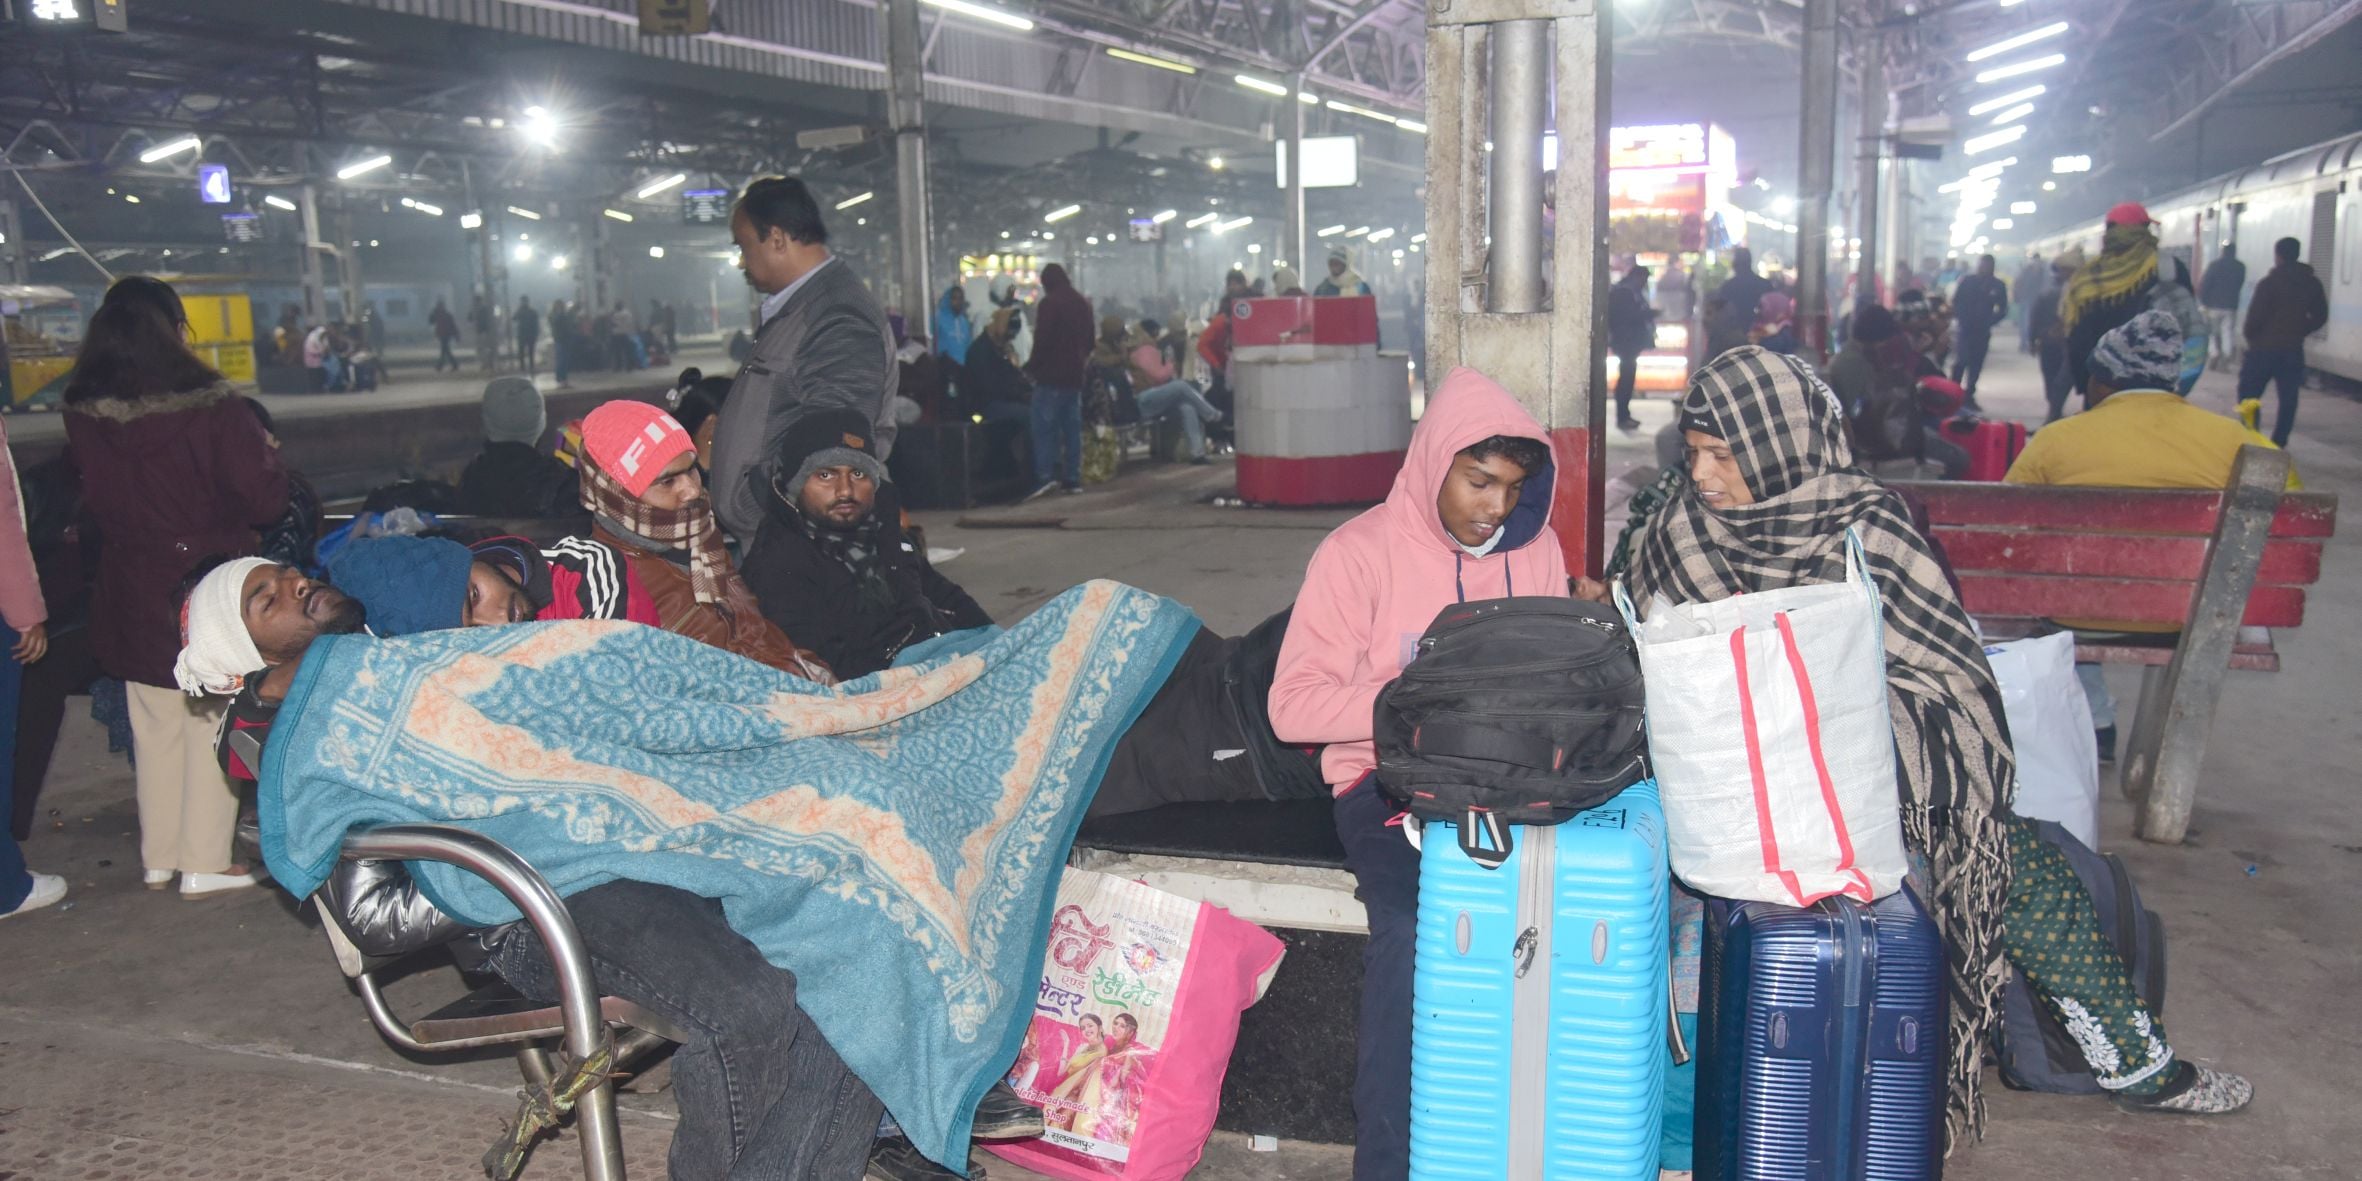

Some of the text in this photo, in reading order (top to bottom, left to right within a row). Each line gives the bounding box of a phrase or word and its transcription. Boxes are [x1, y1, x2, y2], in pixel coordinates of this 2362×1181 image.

[206, 172, 229, 203] 4
[1038, 1092, 1090, 1113] Readymade
[1045, 1108, 1067, 1122] Shop
